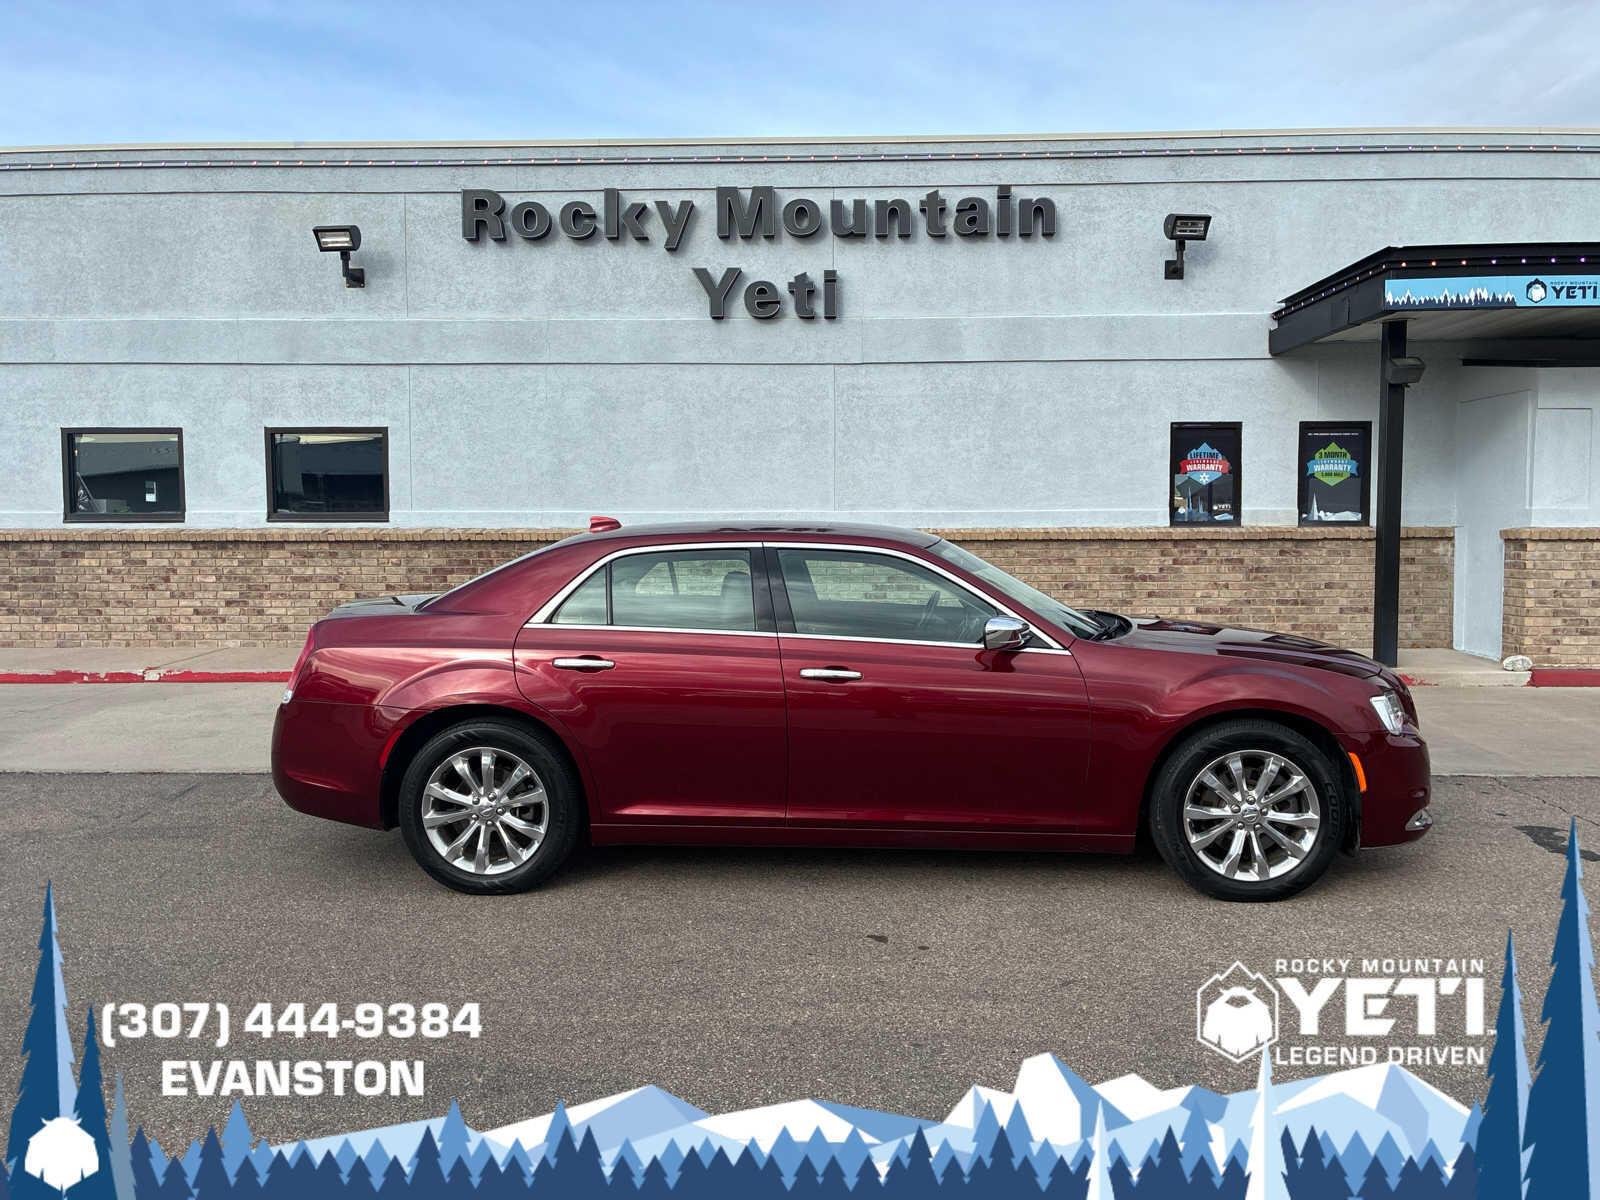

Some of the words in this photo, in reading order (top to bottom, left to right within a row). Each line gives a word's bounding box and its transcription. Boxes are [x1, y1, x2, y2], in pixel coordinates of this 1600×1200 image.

[461, 187, 694, 251] Rocky
[716, 184, 1058, 240] Mountain
[692, 267, 838, 320] Yeti
[1551, 286, 1597, 299] YETI
[1190, 451, 1220, 459] LIFETIME
[1324, 451, 1347, 459] MONTH
[1314, 464, 1351, 472] WARRANTY
